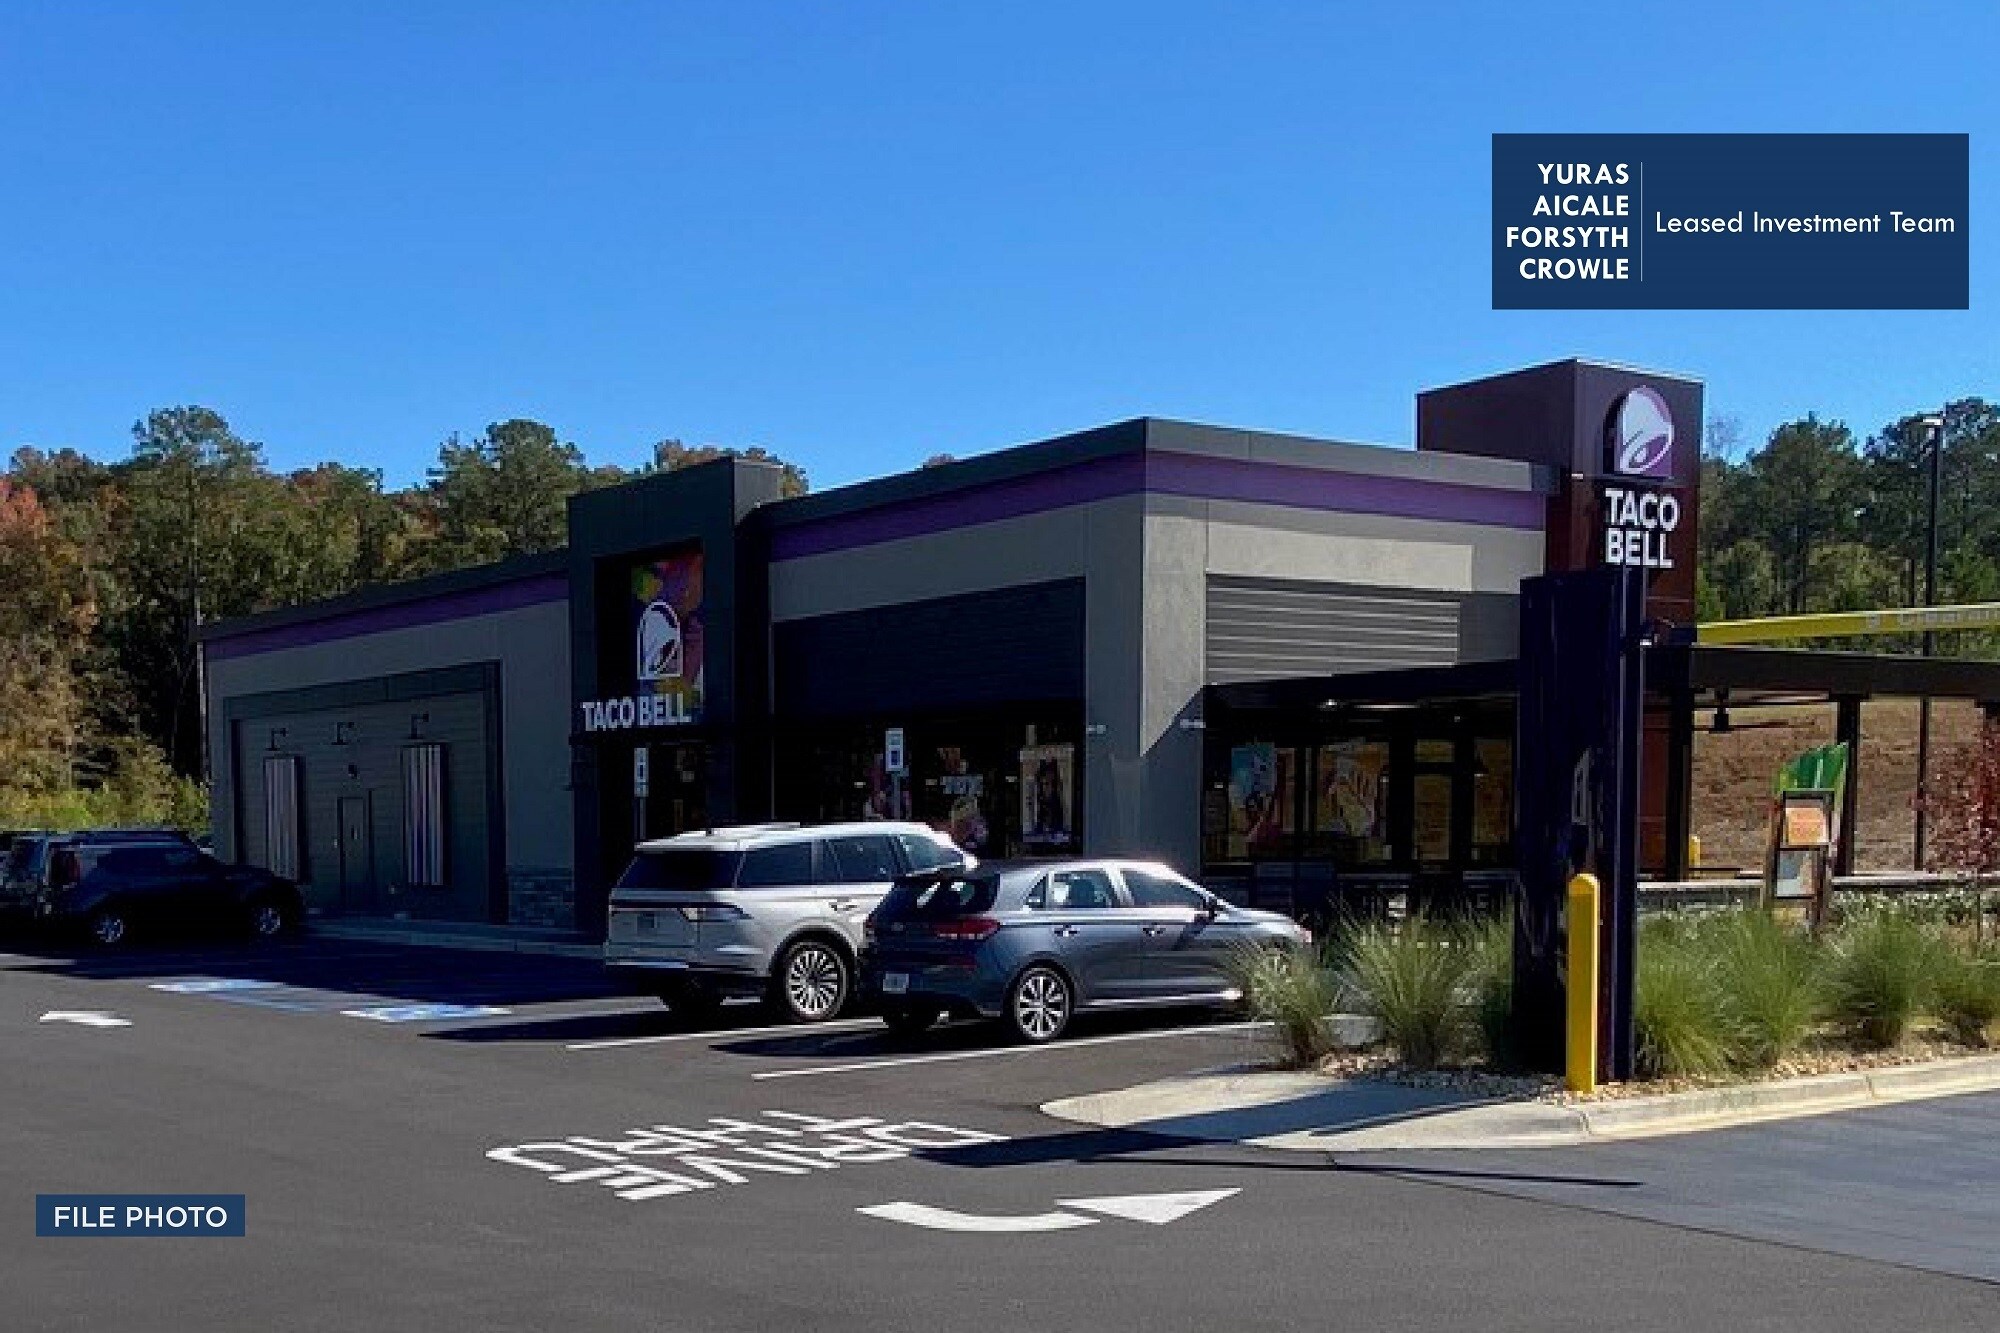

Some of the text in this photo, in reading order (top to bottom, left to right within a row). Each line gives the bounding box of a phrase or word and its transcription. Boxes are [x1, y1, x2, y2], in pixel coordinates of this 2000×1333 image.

[1605, 487, 1680, 531] TACO
[1605, 527, 1674, 569] BELL
[582, 691, 692, 732] TACO BELL
